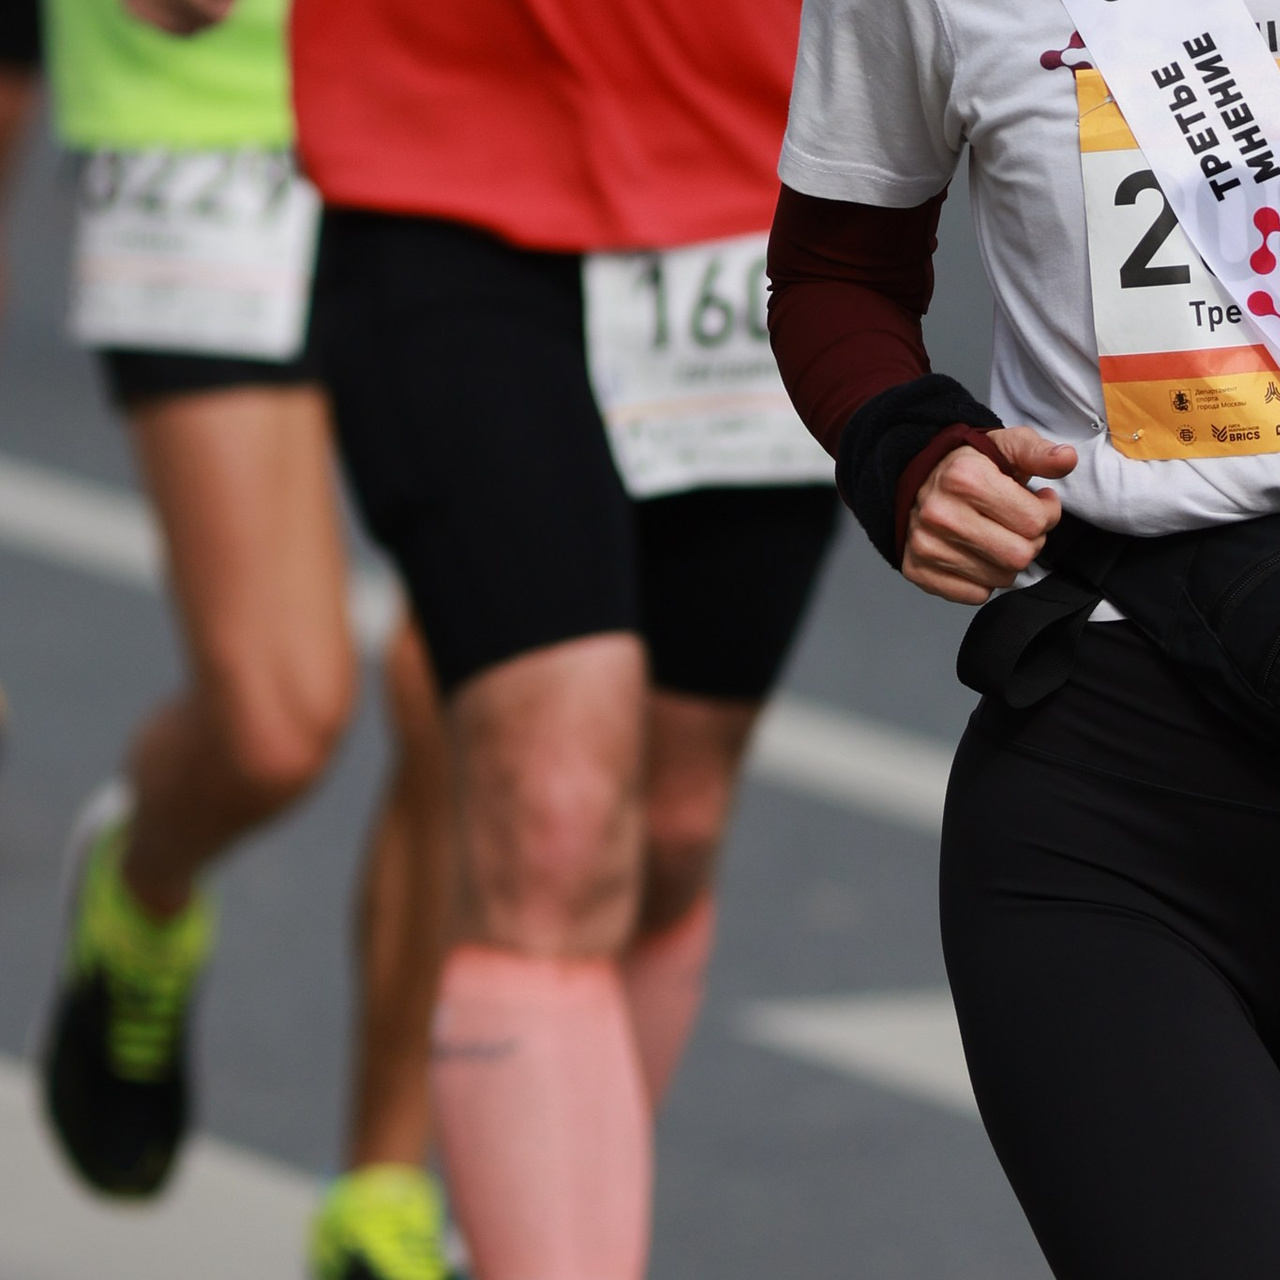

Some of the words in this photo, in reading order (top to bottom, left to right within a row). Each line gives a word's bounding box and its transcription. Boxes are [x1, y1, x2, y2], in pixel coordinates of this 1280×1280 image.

[1151, 61, 1242, 202] ТРЕТЬЕ
[1189, 300, 1243, 332] Тре
[1229, 431, 1260, 442] BRICS
